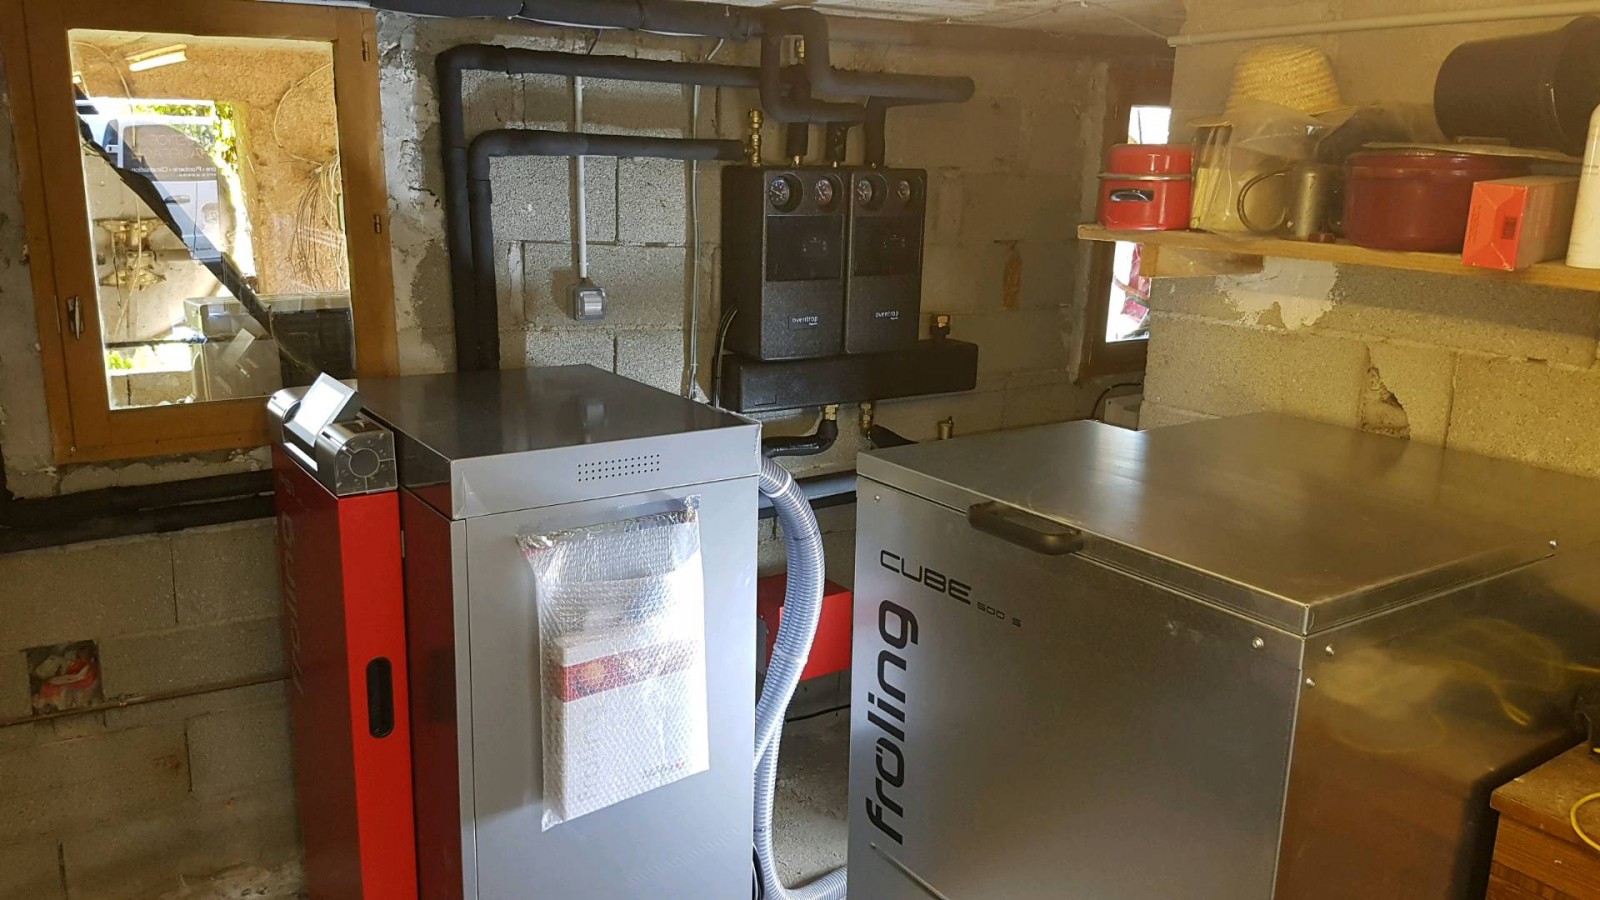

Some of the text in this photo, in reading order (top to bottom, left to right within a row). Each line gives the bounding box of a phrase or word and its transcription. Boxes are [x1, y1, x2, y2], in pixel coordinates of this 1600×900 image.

[880, 549, 1021, 627] CUBE 500 S
[866, 599, 919, 846] fröling
